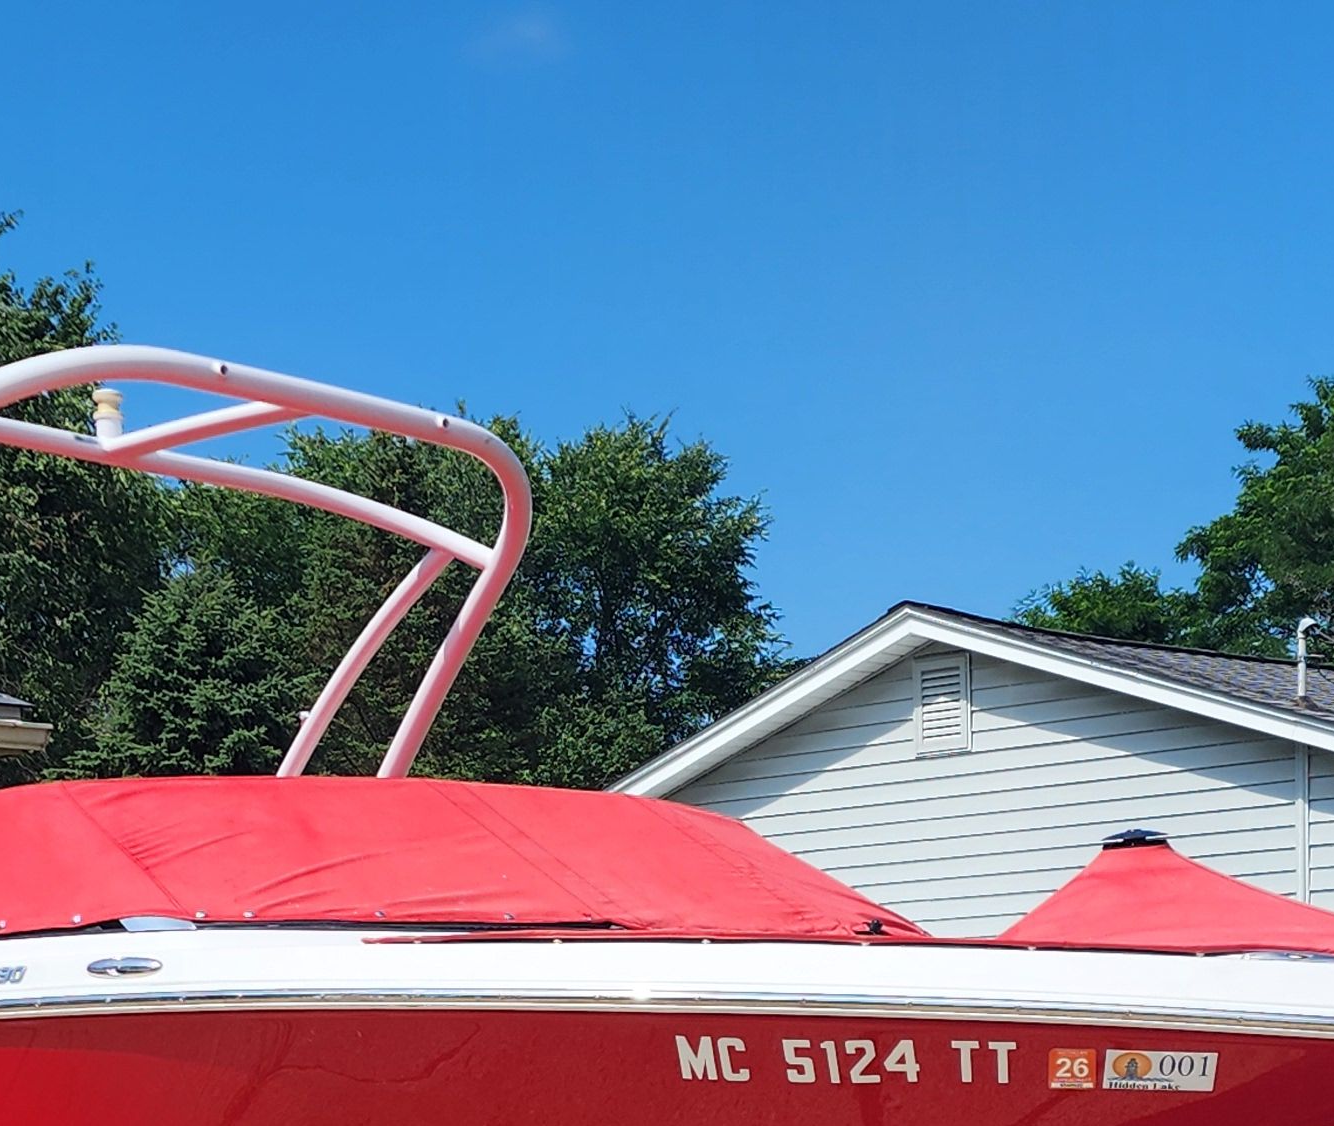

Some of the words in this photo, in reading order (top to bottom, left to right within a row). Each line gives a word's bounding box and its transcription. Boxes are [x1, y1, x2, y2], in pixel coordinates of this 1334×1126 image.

[675, 1035, 750, 1082] MC
[781, 1038, 920, 1084] 5124
[951, 1040, 1017, 1084] TT
[1055, 1057, 1089, 1078] 26
[1159, 1054, 1209, 1077] 001
